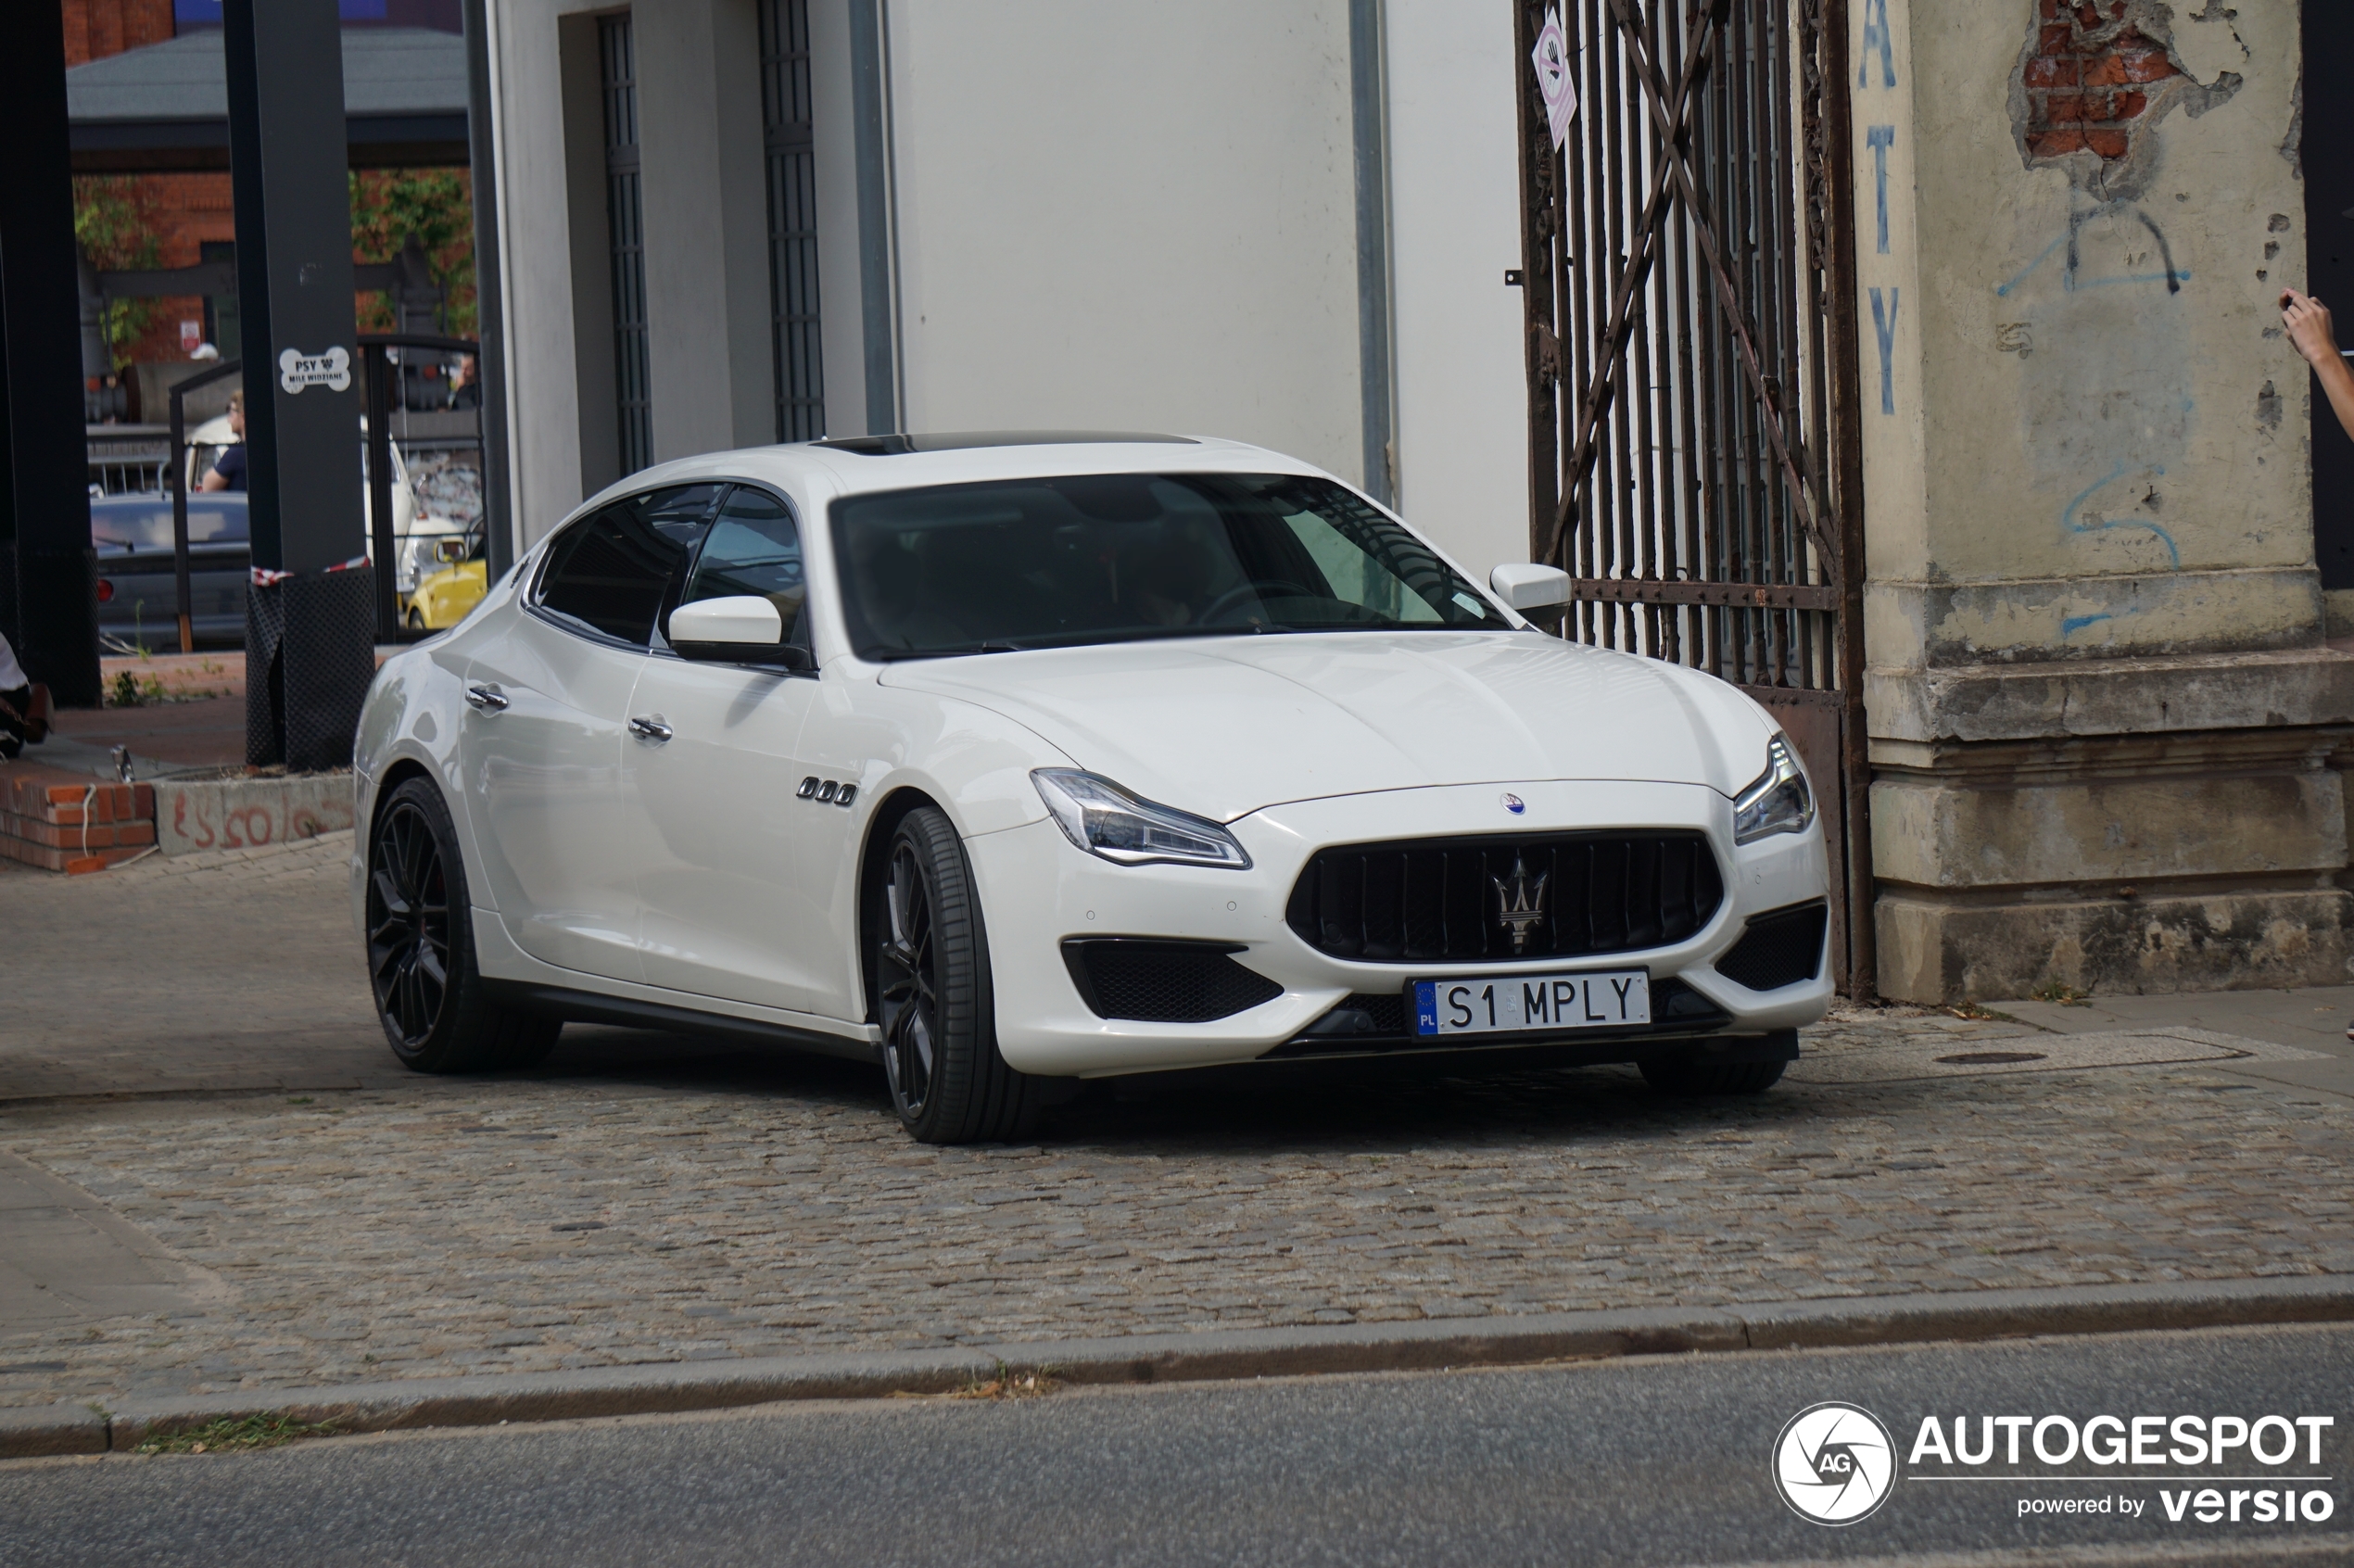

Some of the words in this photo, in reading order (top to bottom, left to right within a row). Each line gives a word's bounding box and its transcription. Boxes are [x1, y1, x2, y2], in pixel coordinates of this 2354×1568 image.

[295, 360, 317, 373] PSY
[288, 374, 306, 384] MILE
[307, 373, 344, 383] WIDZIANE
[1448, 984, 1497, 1028] S1
[1523, 977, 1632, 1025] MPLY
[1420, 1014, 1436, 1027] PL
